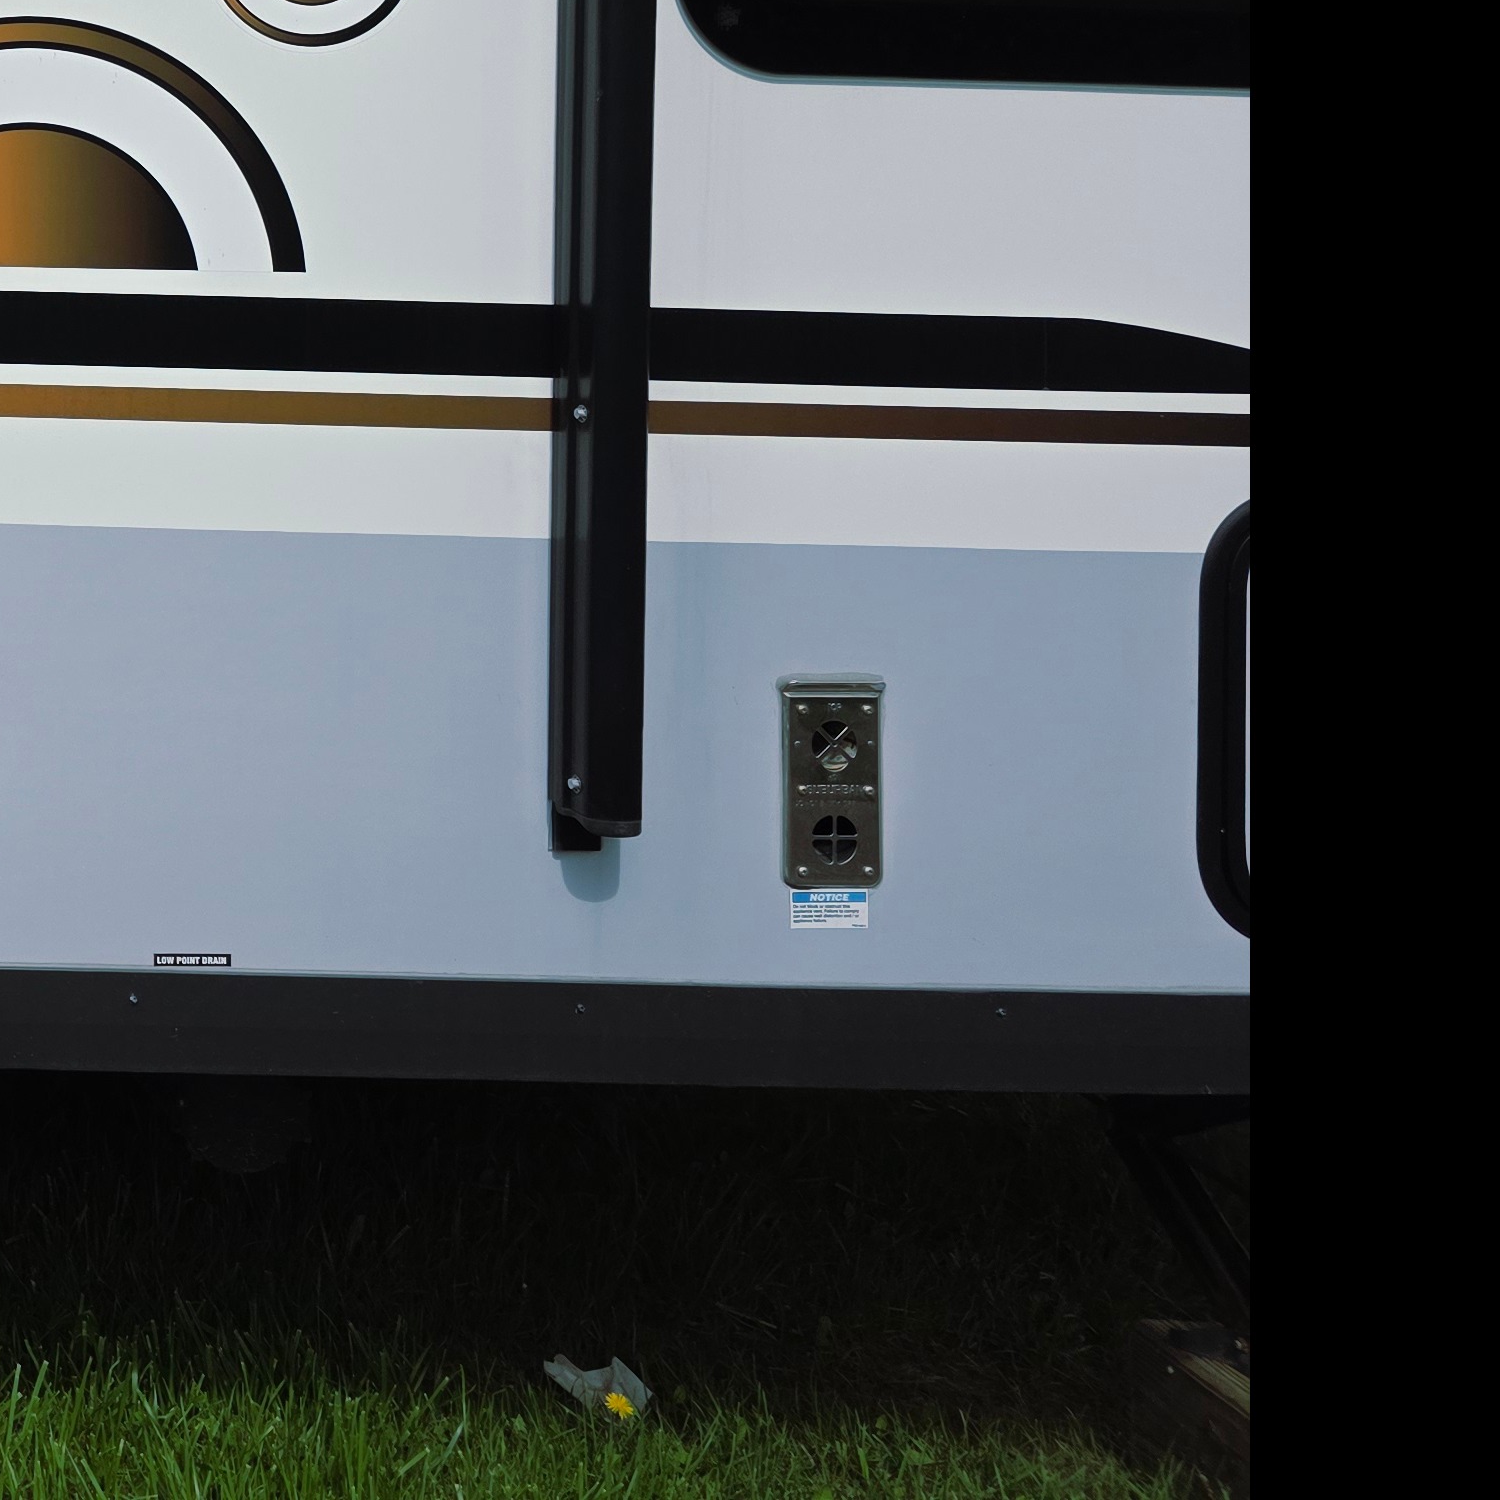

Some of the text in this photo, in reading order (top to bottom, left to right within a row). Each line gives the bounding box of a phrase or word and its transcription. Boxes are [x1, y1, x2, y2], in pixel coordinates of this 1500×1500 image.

[809, 893, 850, 902] NOTICE
[156, 956, 227, 965] LOW POINT DRAIN
